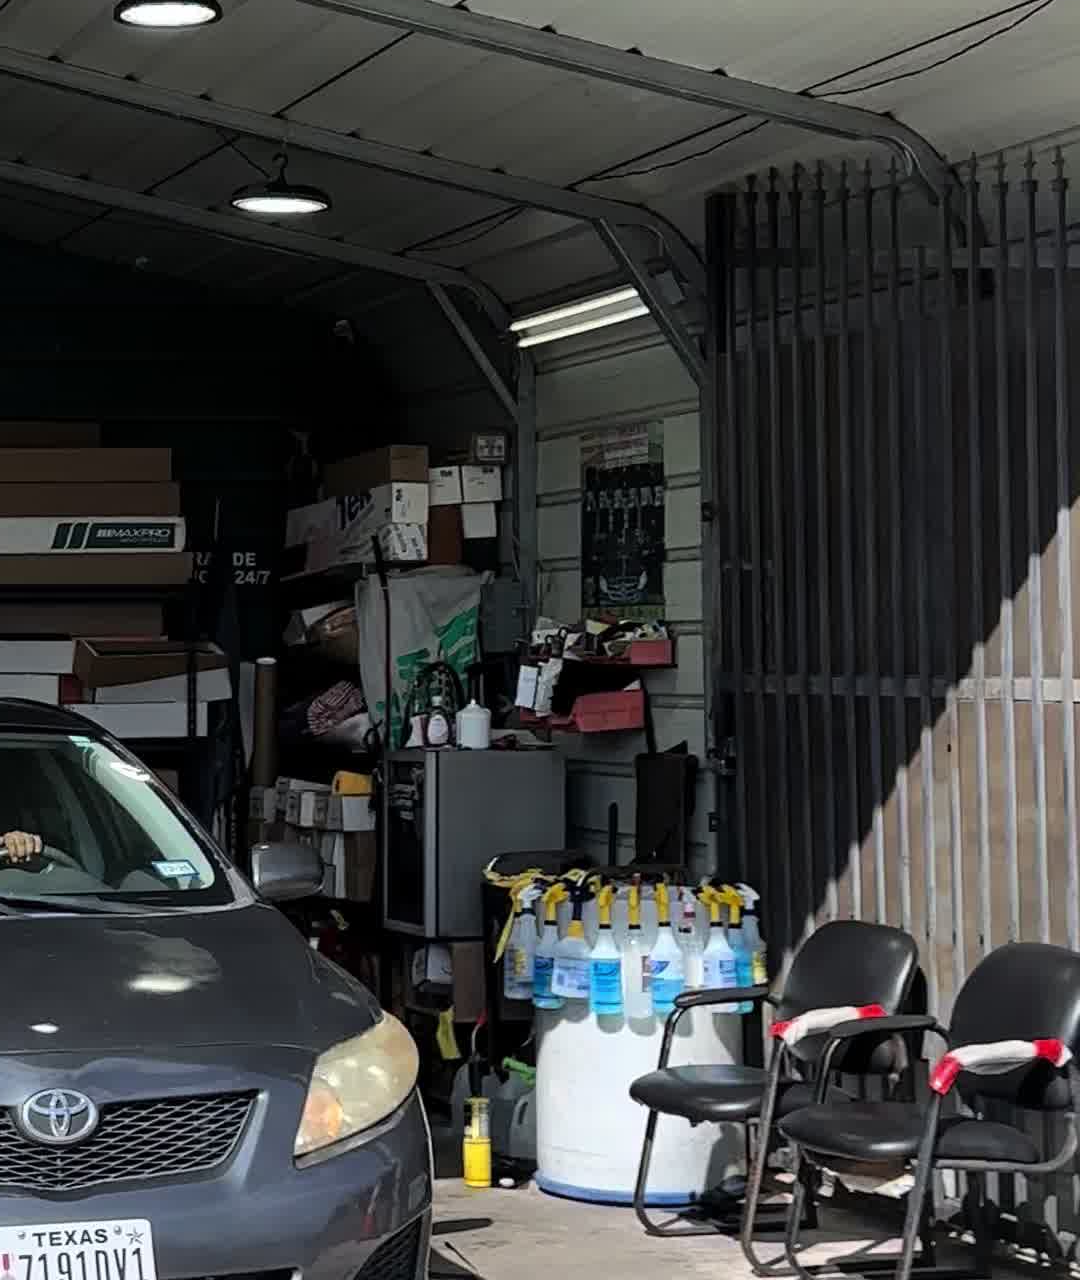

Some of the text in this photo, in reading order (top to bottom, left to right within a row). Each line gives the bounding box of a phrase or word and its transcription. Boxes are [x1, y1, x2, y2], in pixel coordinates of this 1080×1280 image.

[231, 552, 256, 567] DE
[233, 569, 272, 585] 24/7
[32, 1228, 109, 1248] TEXAS
